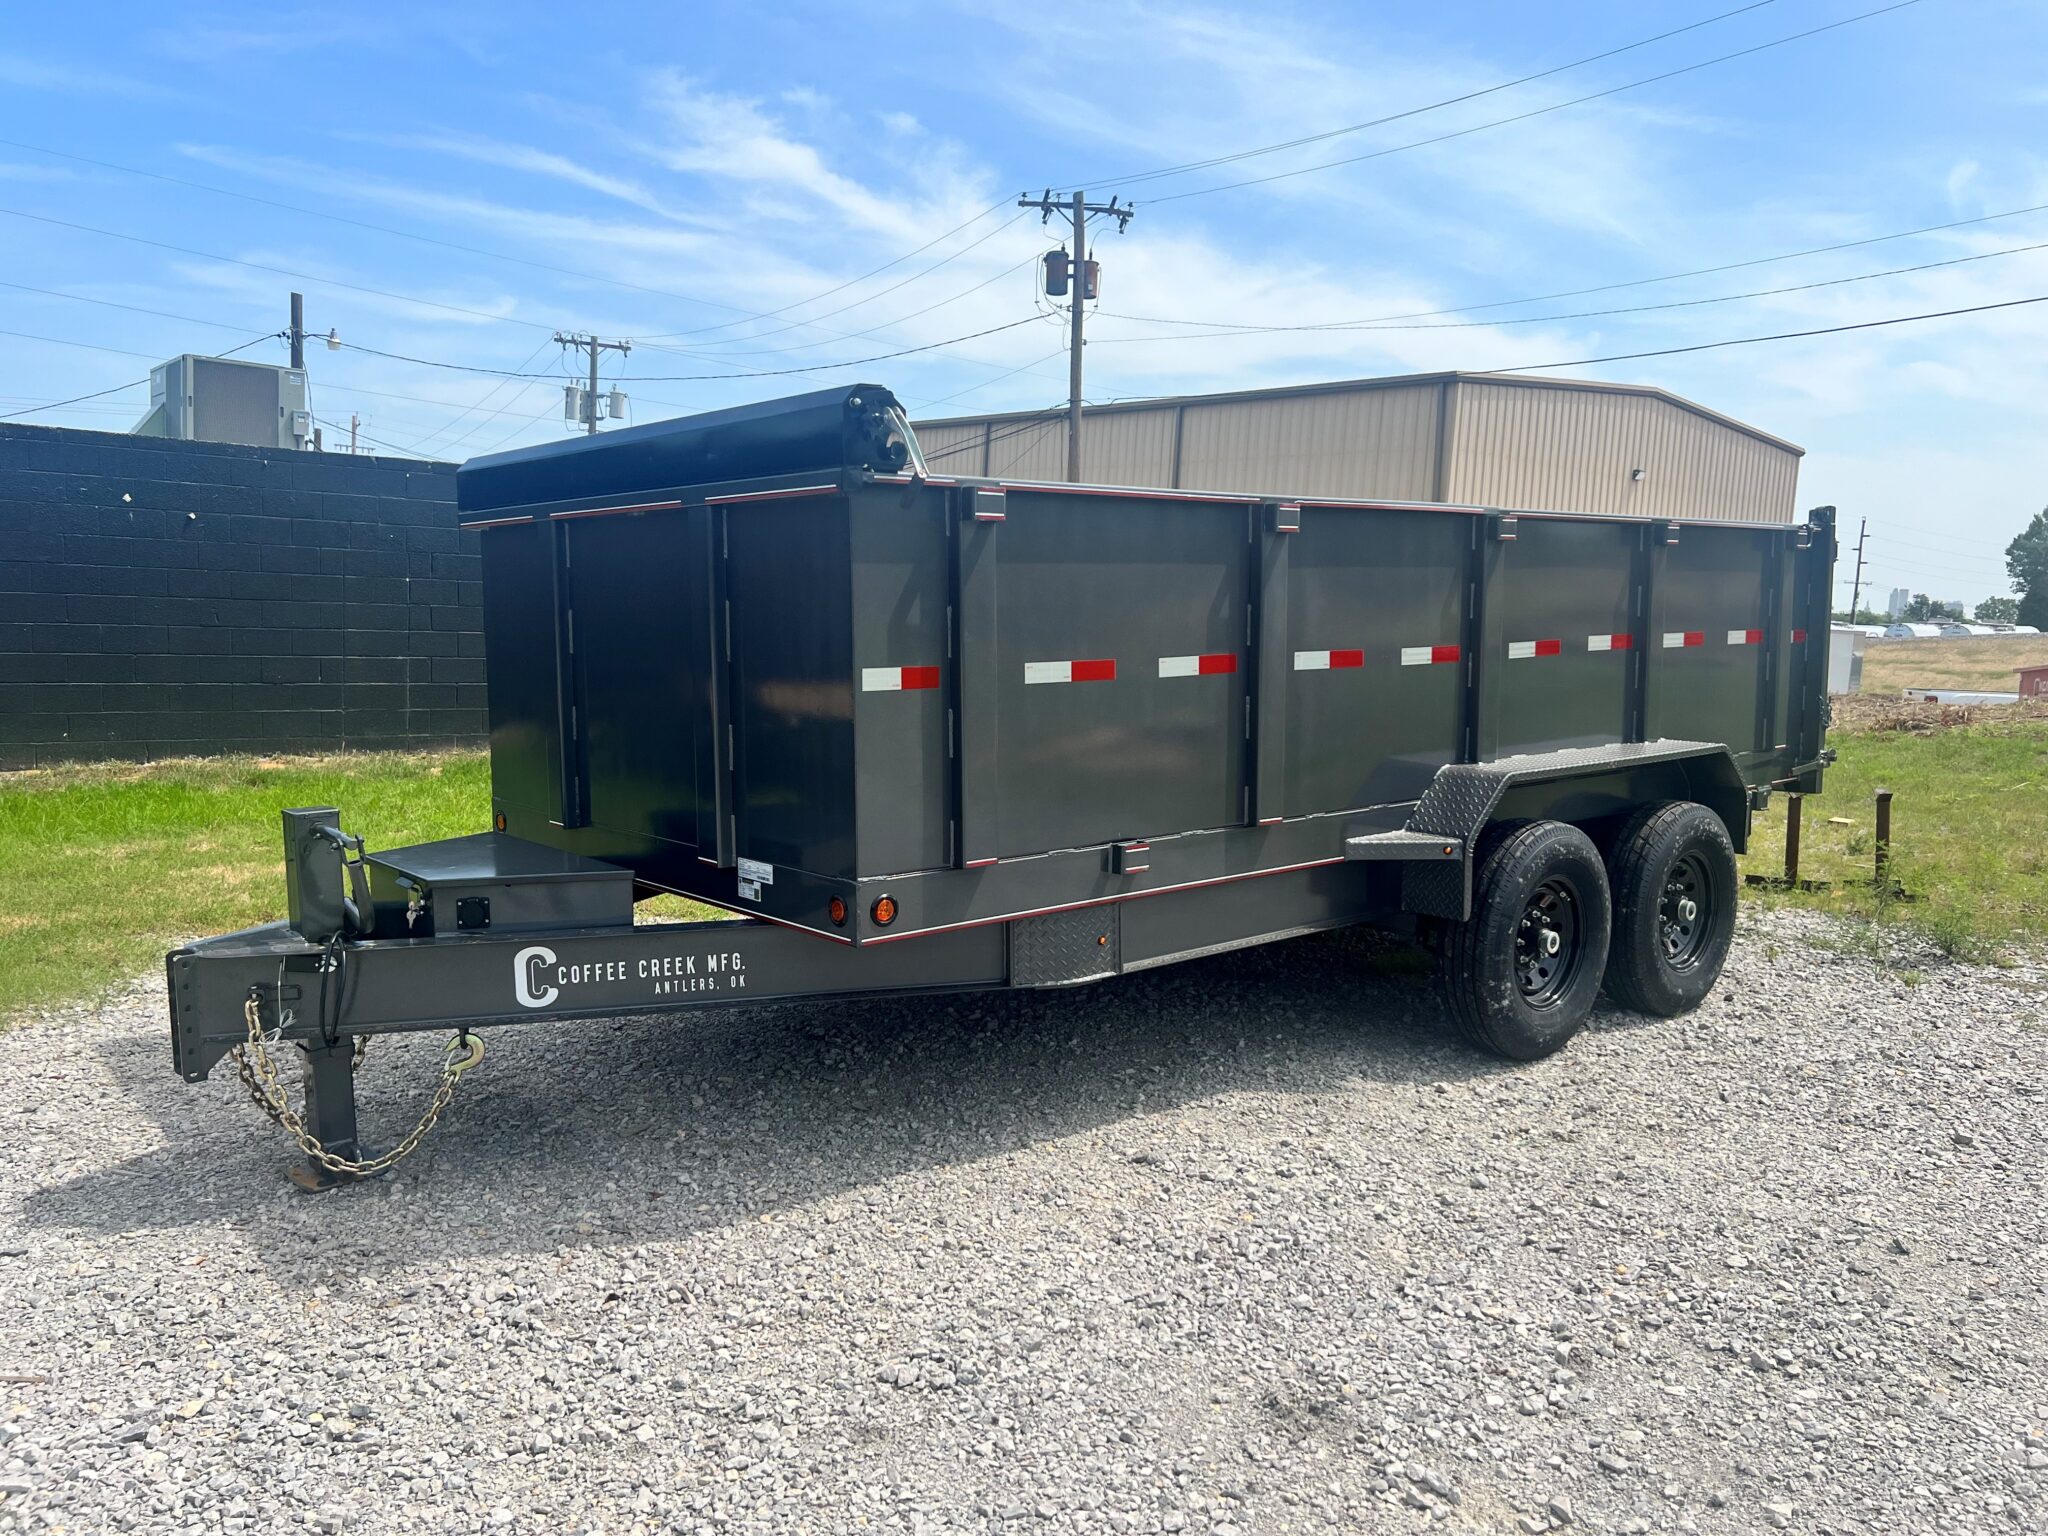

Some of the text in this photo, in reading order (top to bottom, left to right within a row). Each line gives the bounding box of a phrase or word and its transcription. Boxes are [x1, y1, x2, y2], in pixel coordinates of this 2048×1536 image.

[558, 952, 746, 985] COFFEE CREEK MFG.
[730, 974, 746, 988] OK
